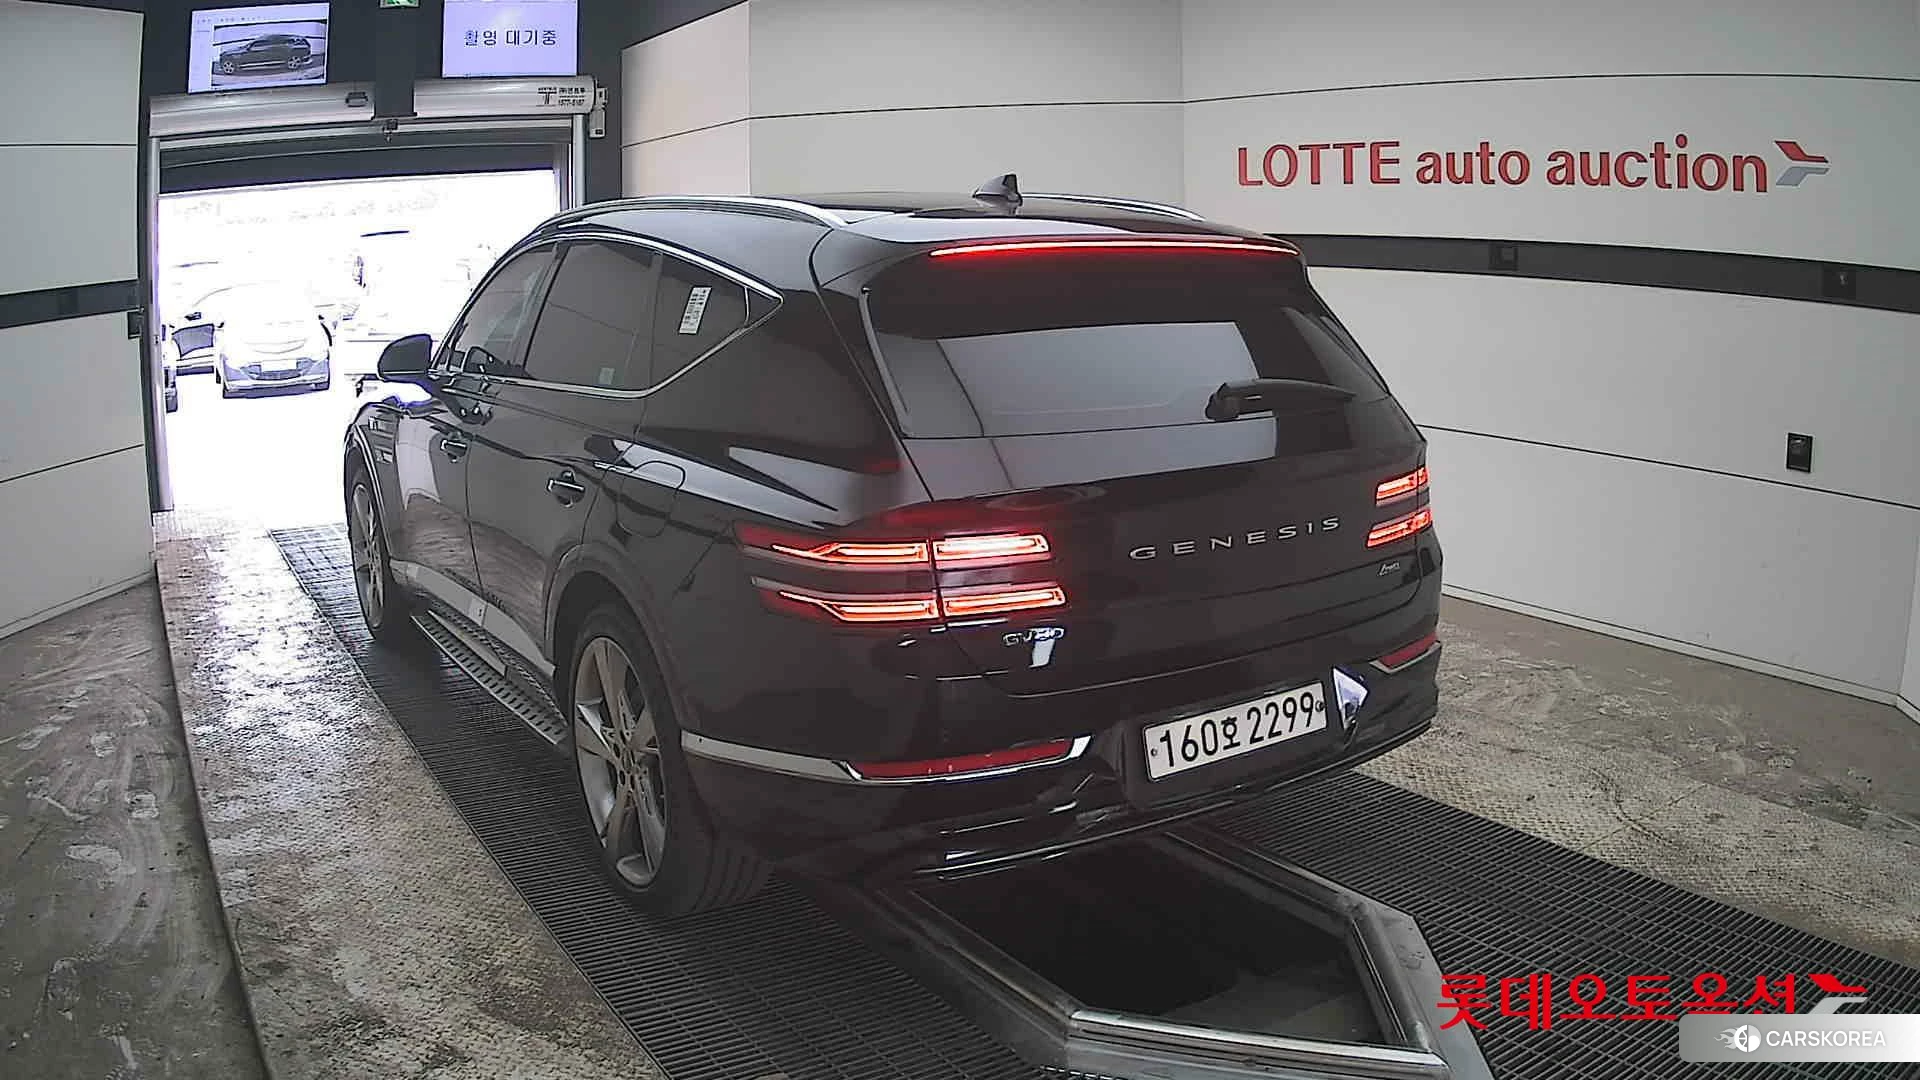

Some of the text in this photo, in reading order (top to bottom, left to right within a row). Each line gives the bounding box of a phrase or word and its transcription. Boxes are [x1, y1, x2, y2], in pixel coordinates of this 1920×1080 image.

[505, 29, 557, 46] 대기중
[1238, 134, 1767, 193] LOTTE auto auction
[1129, 516, 1340, 560] GENESIS
[1159, 691, 1314, 768] 160호 2299
